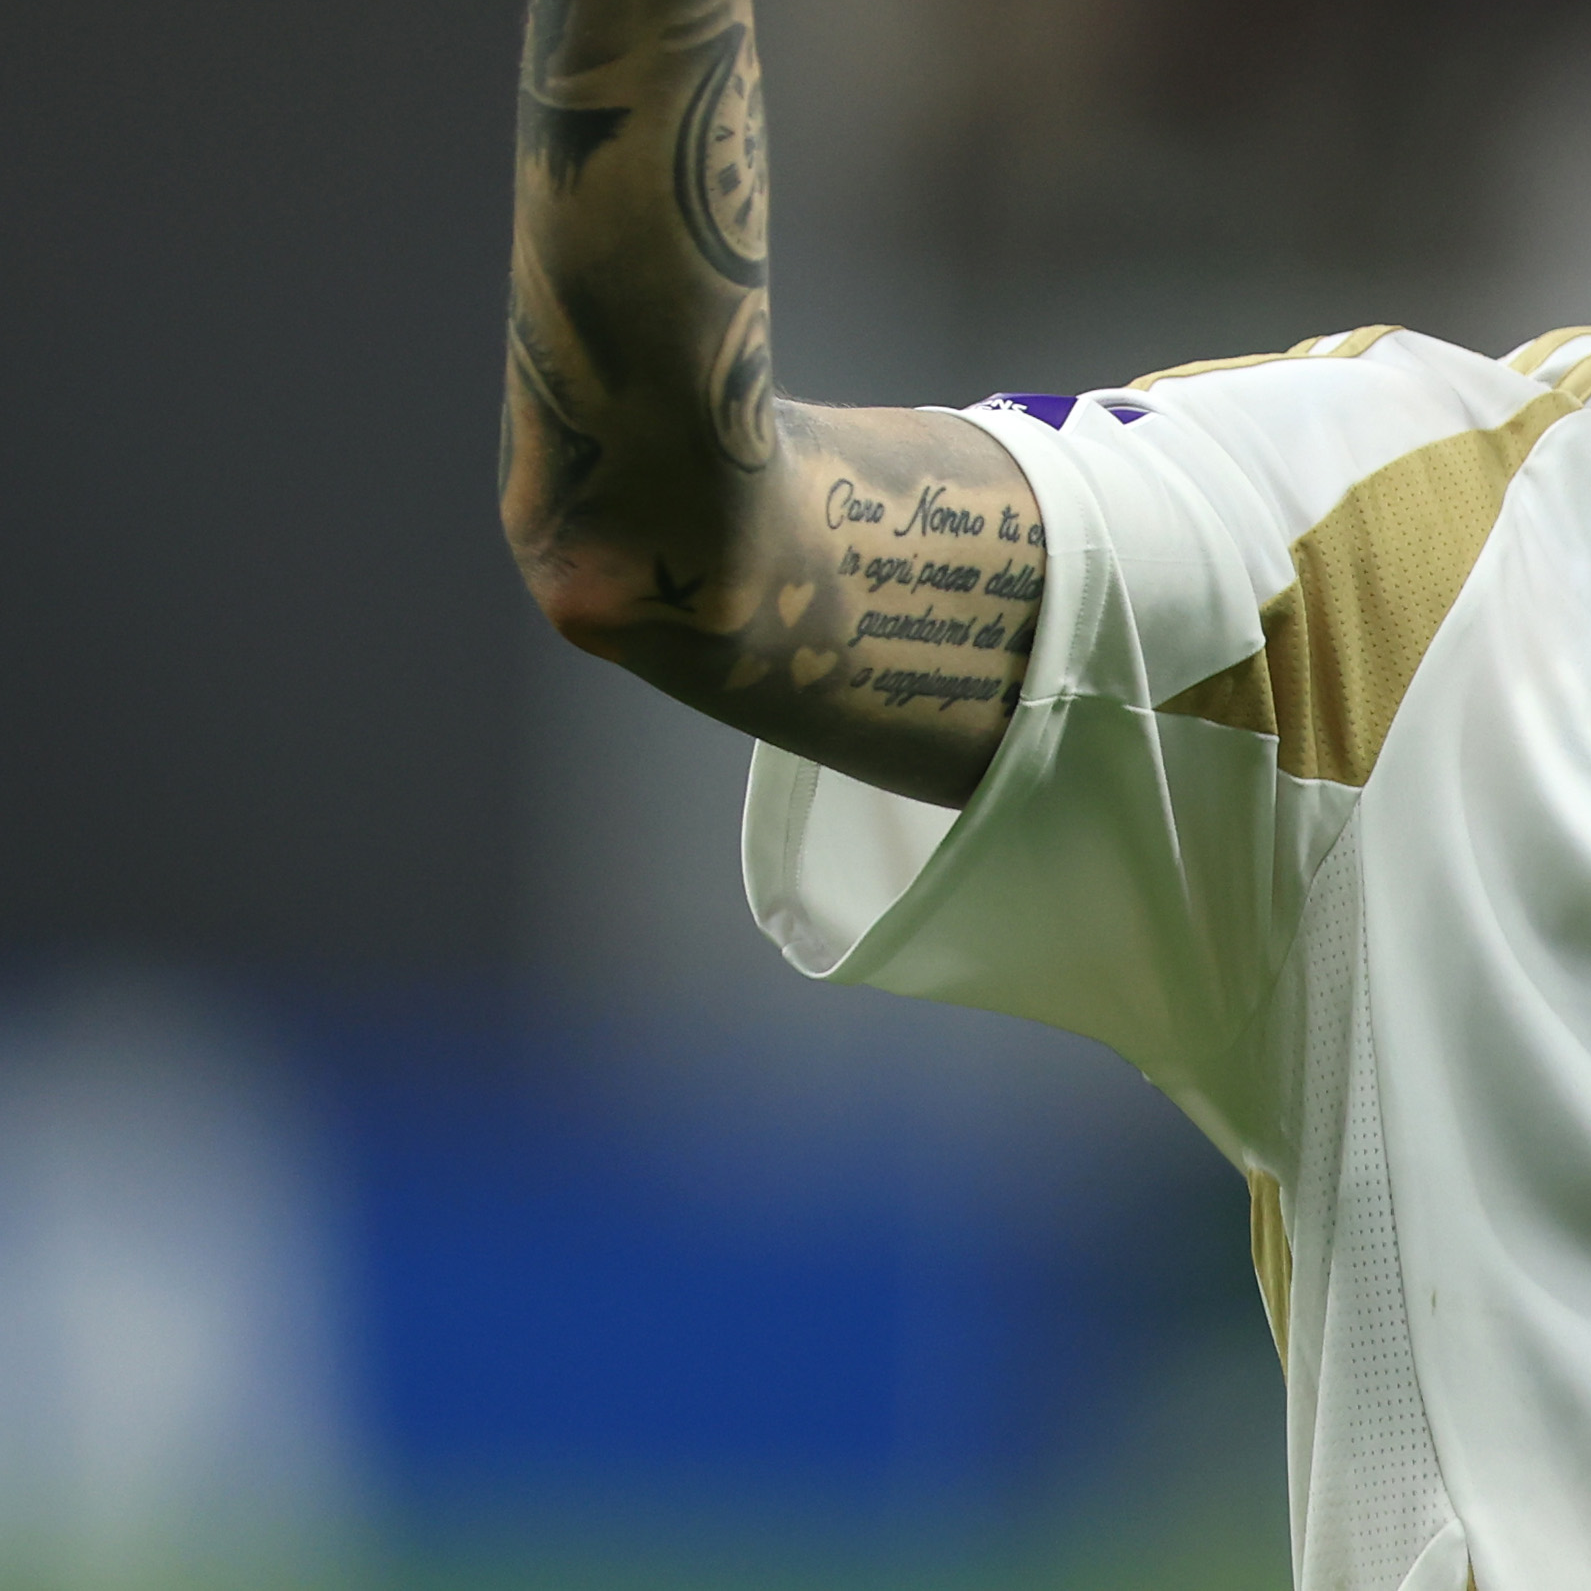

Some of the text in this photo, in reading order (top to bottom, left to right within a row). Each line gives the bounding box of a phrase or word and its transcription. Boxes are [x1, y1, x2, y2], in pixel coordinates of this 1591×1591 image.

[826, 478, 884, 530] Caro
[894, 485, 984, 537] Nonno
[998, 504, 1020, 543] tu
